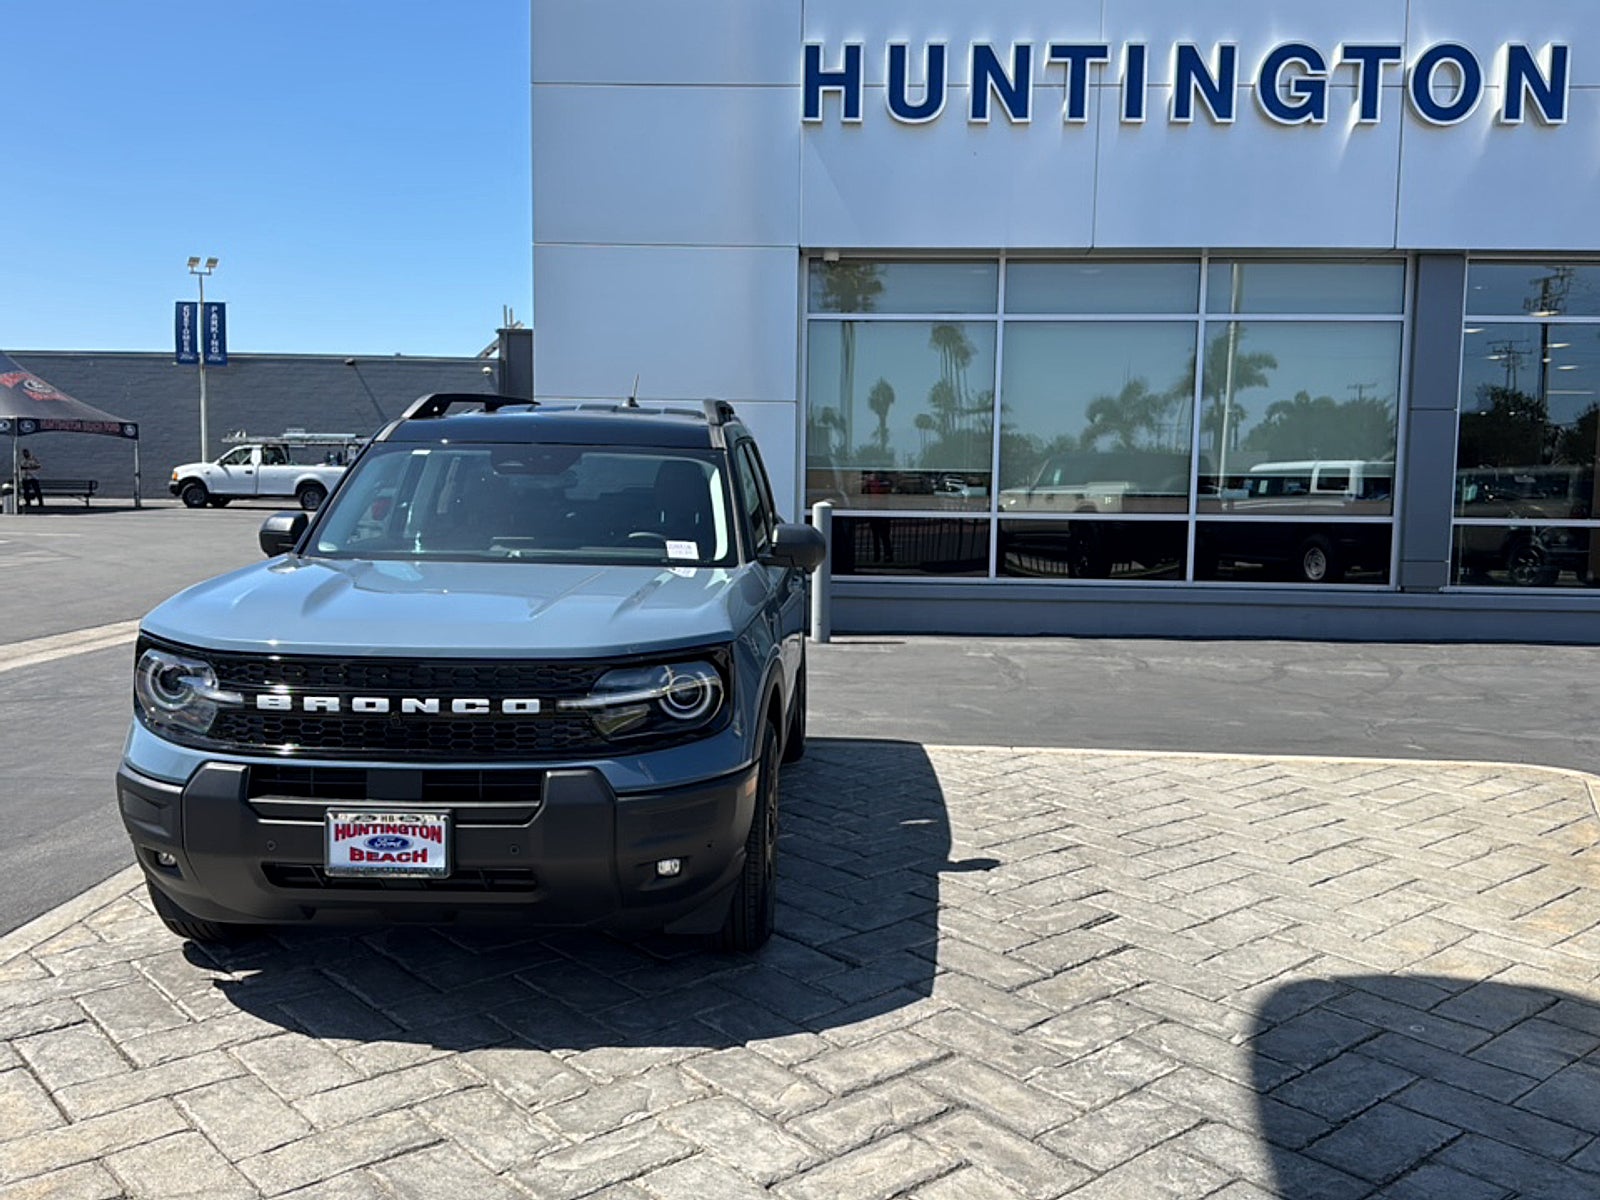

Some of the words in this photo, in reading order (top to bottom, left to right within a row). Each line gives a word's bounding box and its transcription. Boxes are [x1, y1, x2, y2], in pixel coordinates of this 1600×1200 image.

[801, 42, 1570, 126] HUNTINGTON
[211, 305, 219, 353] PARKING
[256, 694, 541, 714] BRONCO
[334, 823, 443, 844] HUNTINGTON
[373, 838, 403, 848] Ford
[349, 847, 428, 863] BEACH
